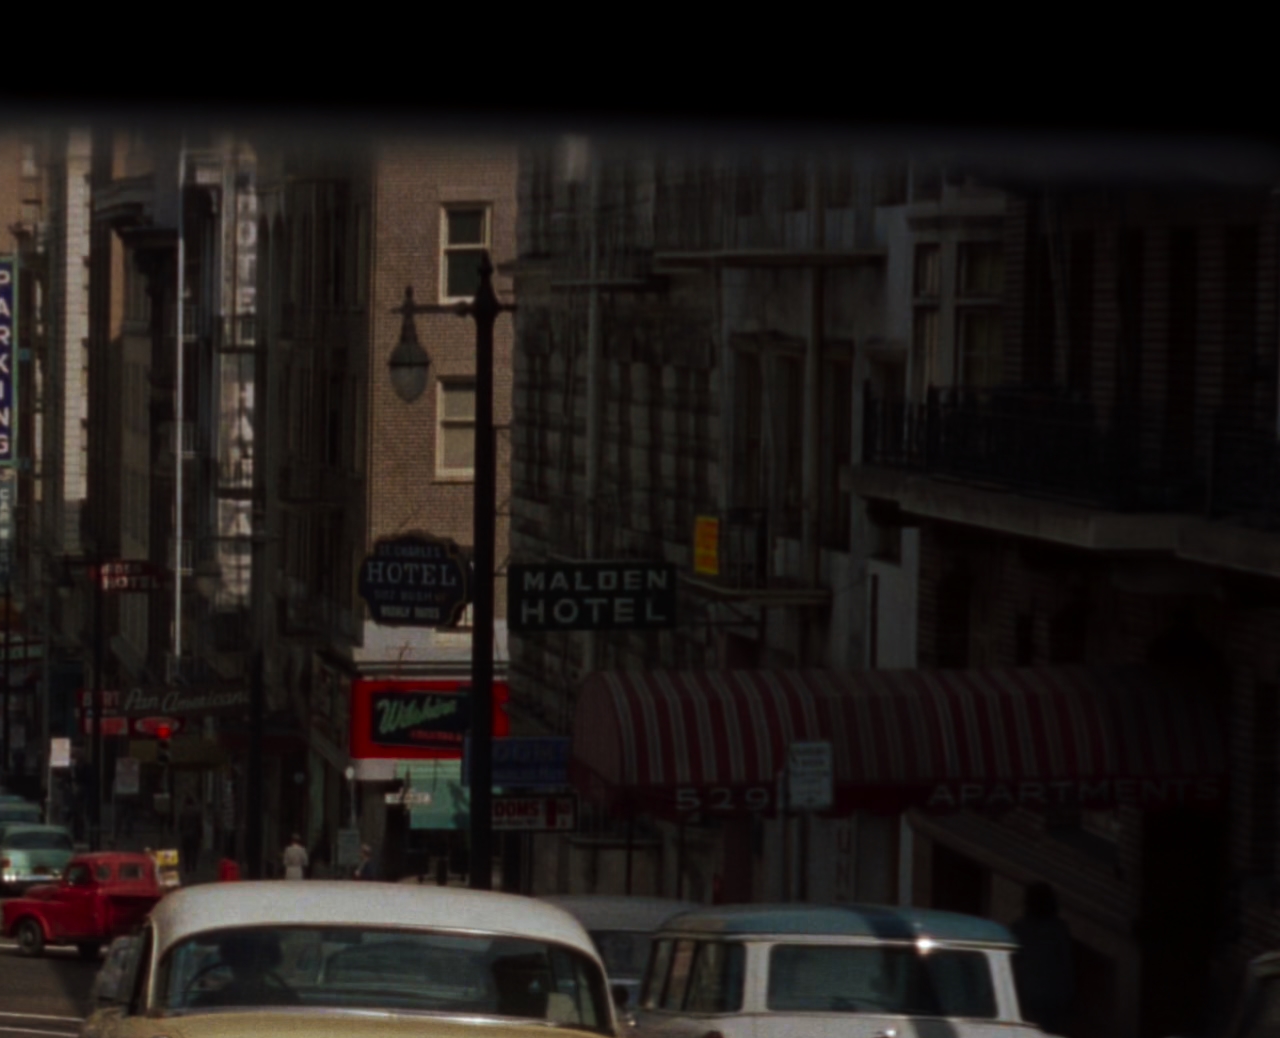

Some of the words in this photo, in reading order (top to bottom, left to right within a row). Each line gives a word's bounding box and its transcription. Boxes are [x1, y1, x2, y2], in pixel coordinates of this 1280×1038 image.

[366, 561, 457, 587] HOTEL
[523, 569, 668, 592] MALDEN
[520, 596, 667, 625] HOTEL
[675, 787, 770, 811] 529
[928, 777, 1221, 807] APARTMENTS
[493, 801, 540, 817] OOMS
